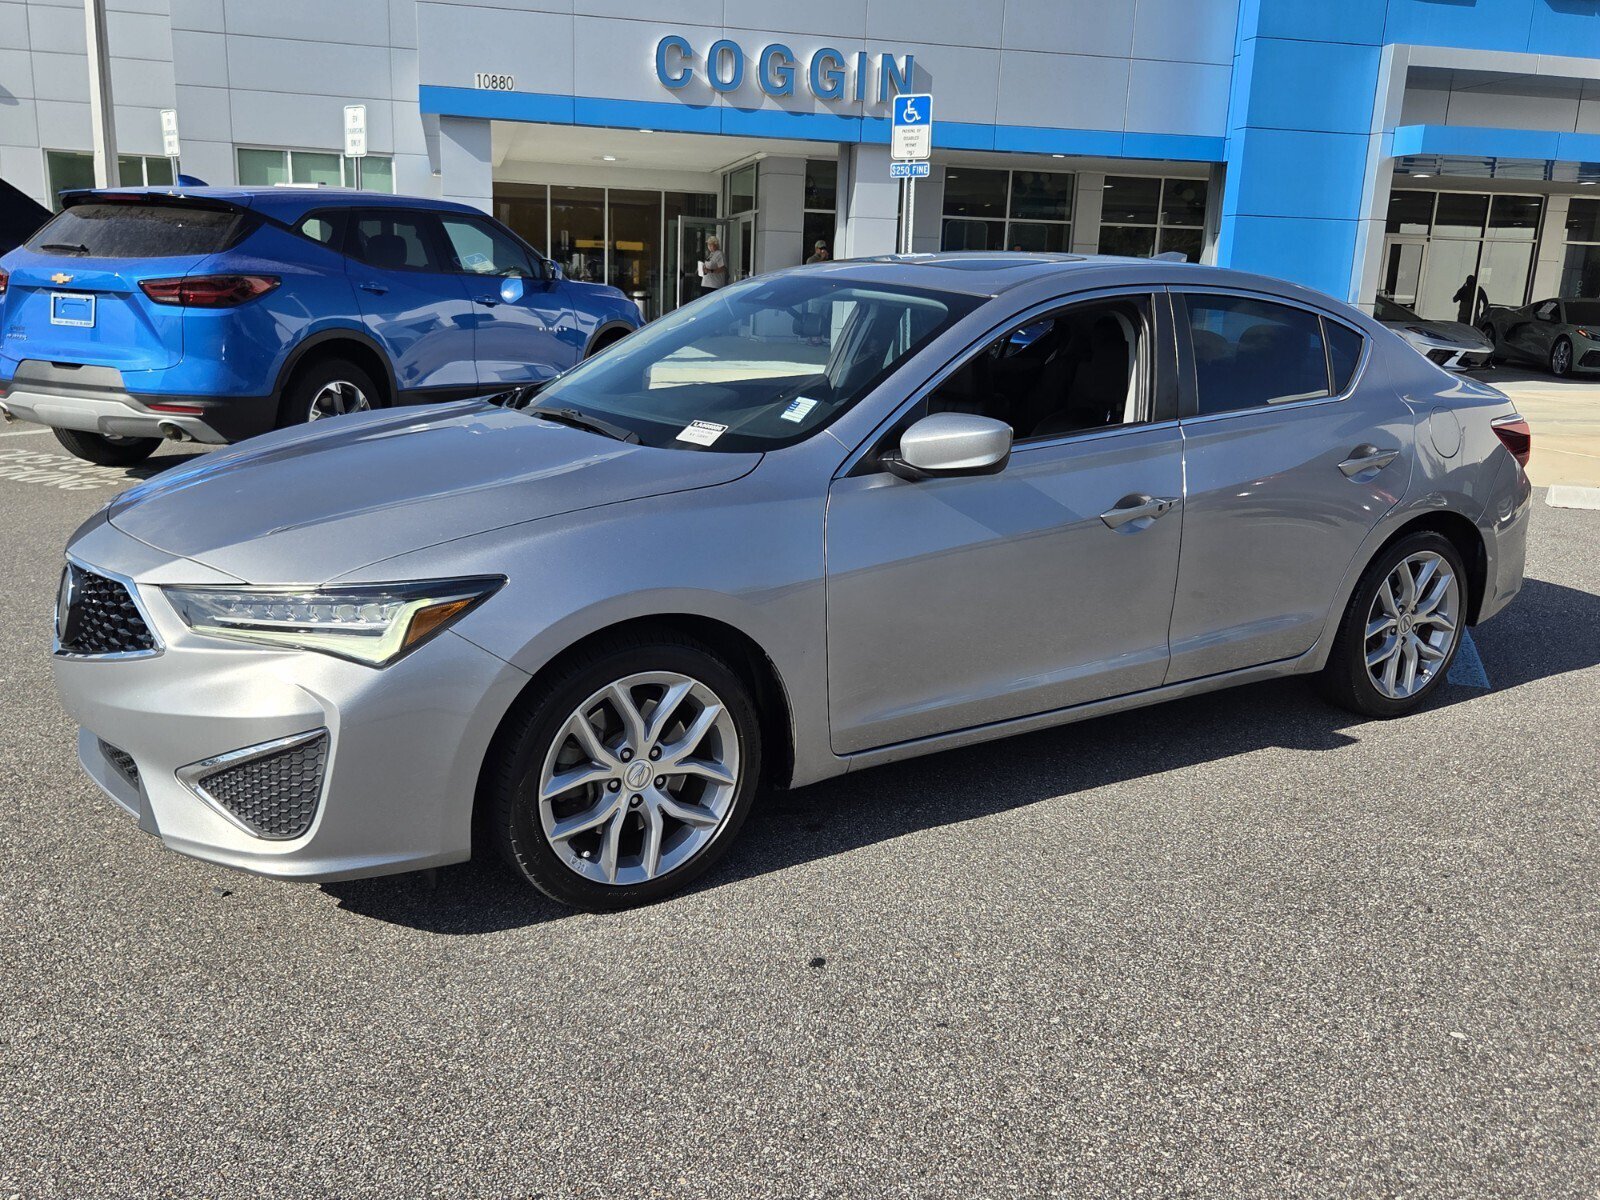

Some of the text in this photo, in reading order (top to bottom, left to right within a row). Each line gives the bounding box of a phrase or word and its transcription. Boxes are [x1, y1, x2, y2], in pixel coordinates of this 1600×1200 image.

[655, 34, 915, 103] COGGIN
[477, 73, 514, 91] 10880
[891, 164, 928, 176] $250 FINE
